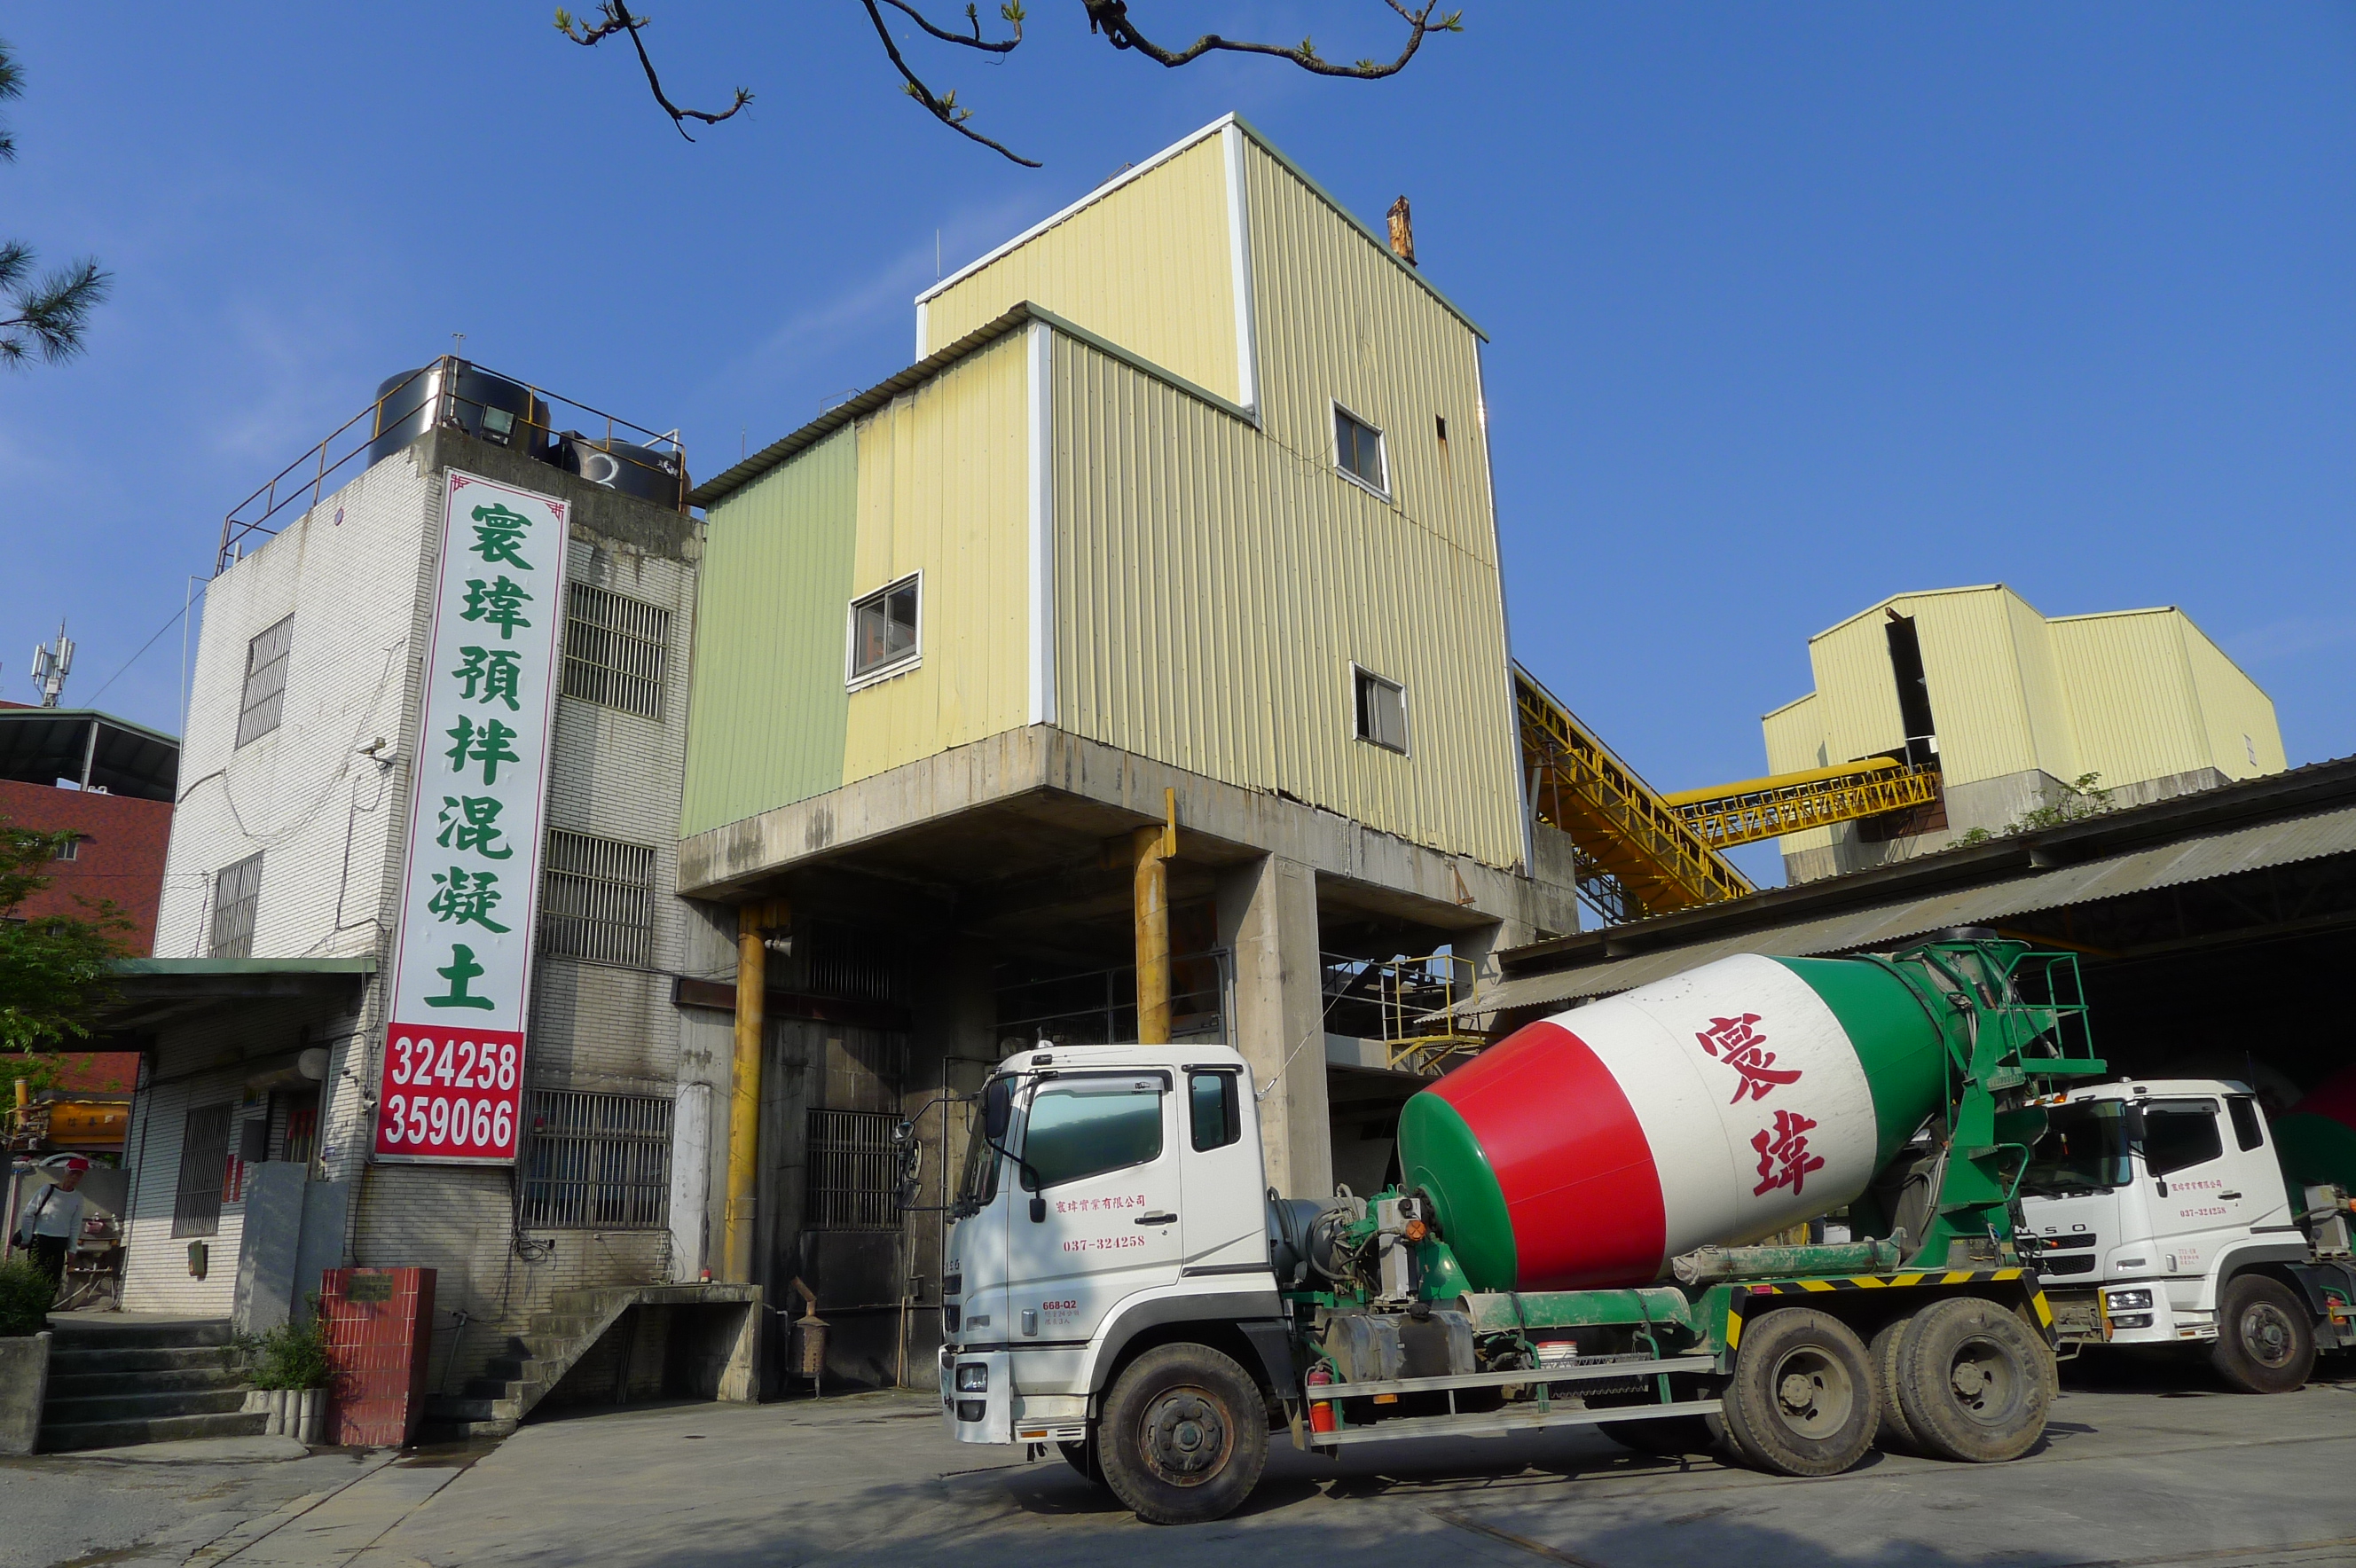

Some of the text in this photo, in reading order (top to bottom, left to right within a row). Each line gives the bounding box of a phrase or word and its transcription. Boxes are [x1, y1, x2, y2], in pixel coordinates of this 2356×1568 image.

[423, 502, 535, 1012] 寰瑋預拌混凝土
[391, 1036, 516, 1091] 324258
[385, 1094, 512, 1148] 359066
[1695, 1012, 1826, 1197] 寰瑋
[1056, 1194, 1145, 1213] 寰瑋實業有限公司
[1063, 1235, 1145, 1252] 037-324258
[1042, 1299, 1077, 1310] 668-Q2
